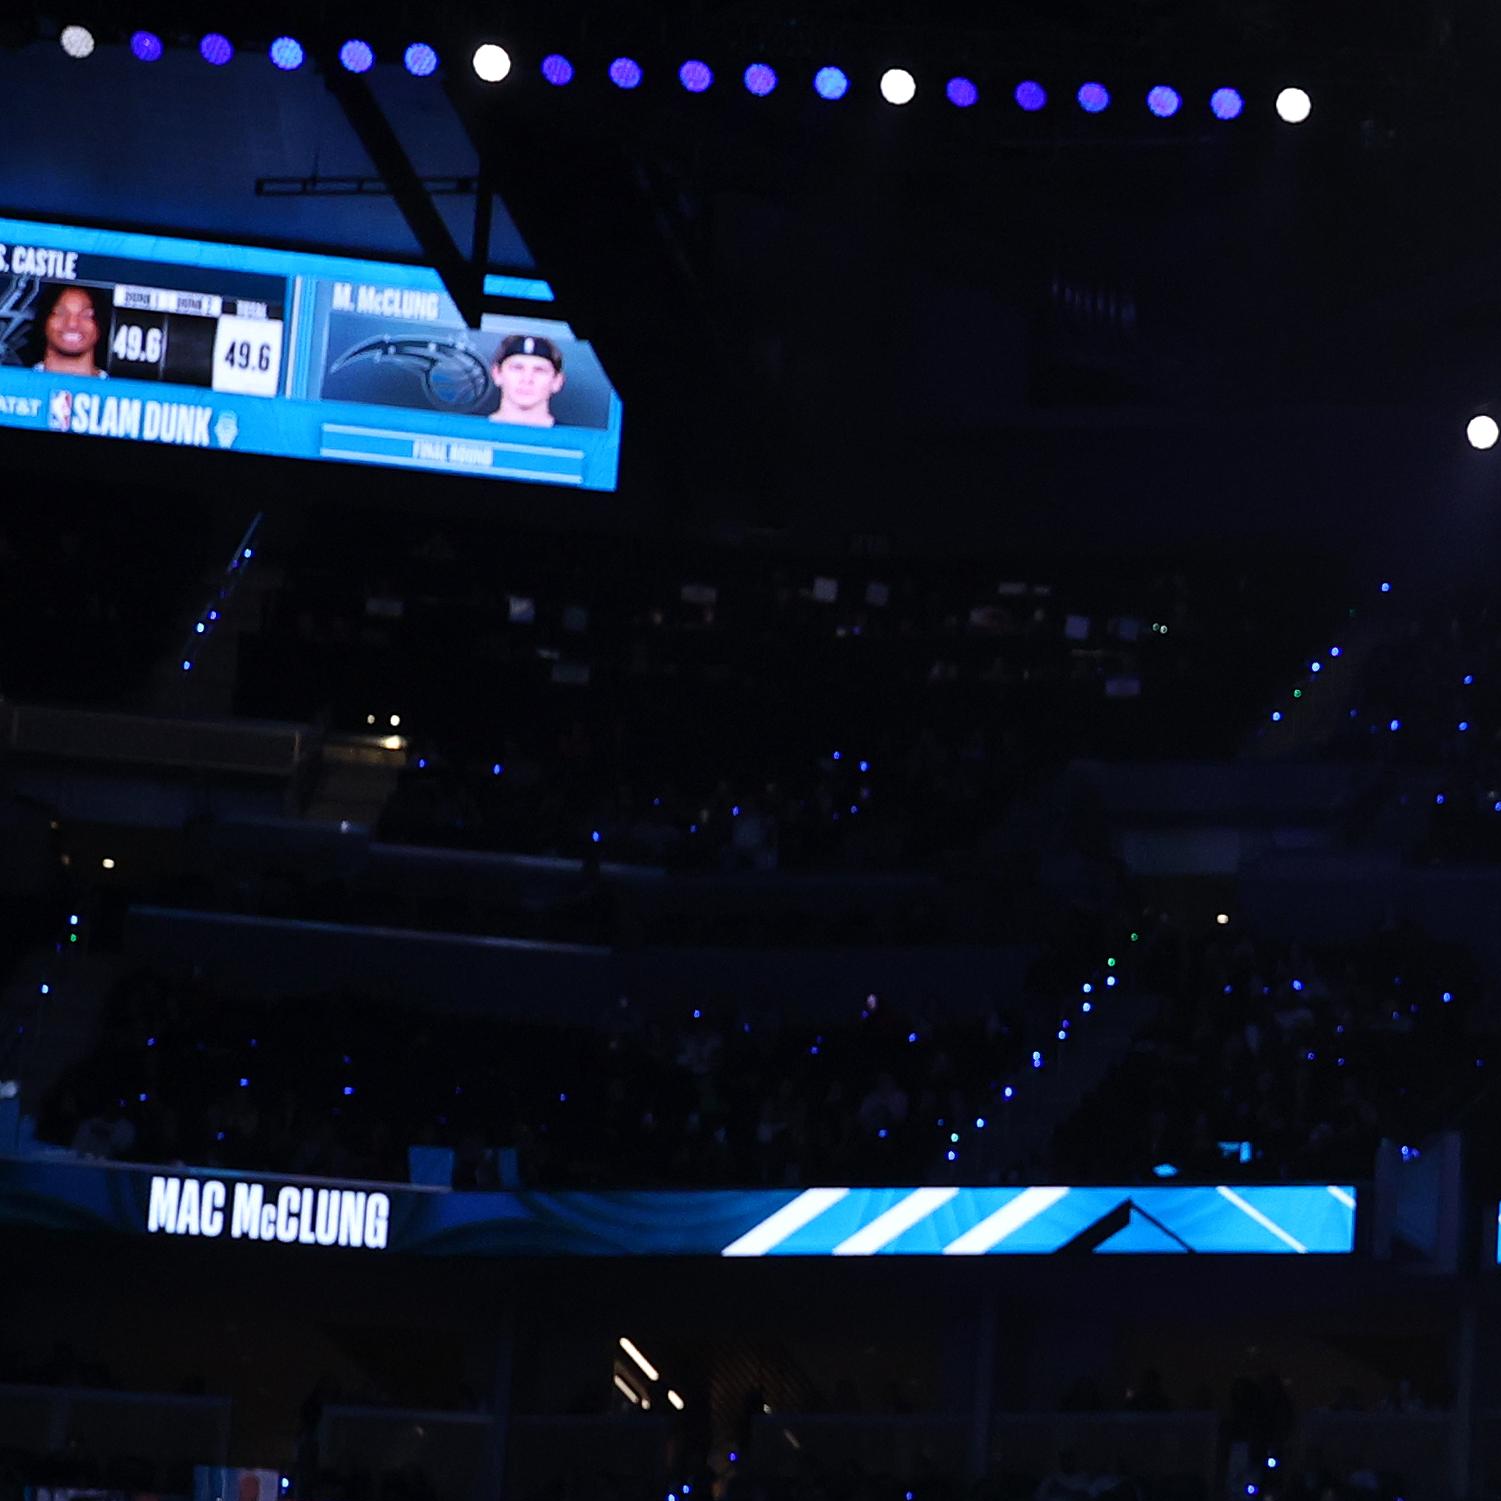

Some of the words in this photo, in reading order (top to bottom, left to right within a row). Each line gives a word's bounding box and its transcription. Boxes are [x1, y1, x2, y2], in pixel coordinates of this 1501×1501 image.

[12, 245, 78, 279] CASTLE
[357, 285, 440, 321] McCLUNG
[113, 324, 163, 362] 49.6
[224, 340, 272, 372] 49.6
[71, 392, 142, 439] SLAM
[143, 399, 212, 447] DUNK
[148, 1177, 225, 1237] MAC
[231, 1182, 389, 1249] McCLUNG
